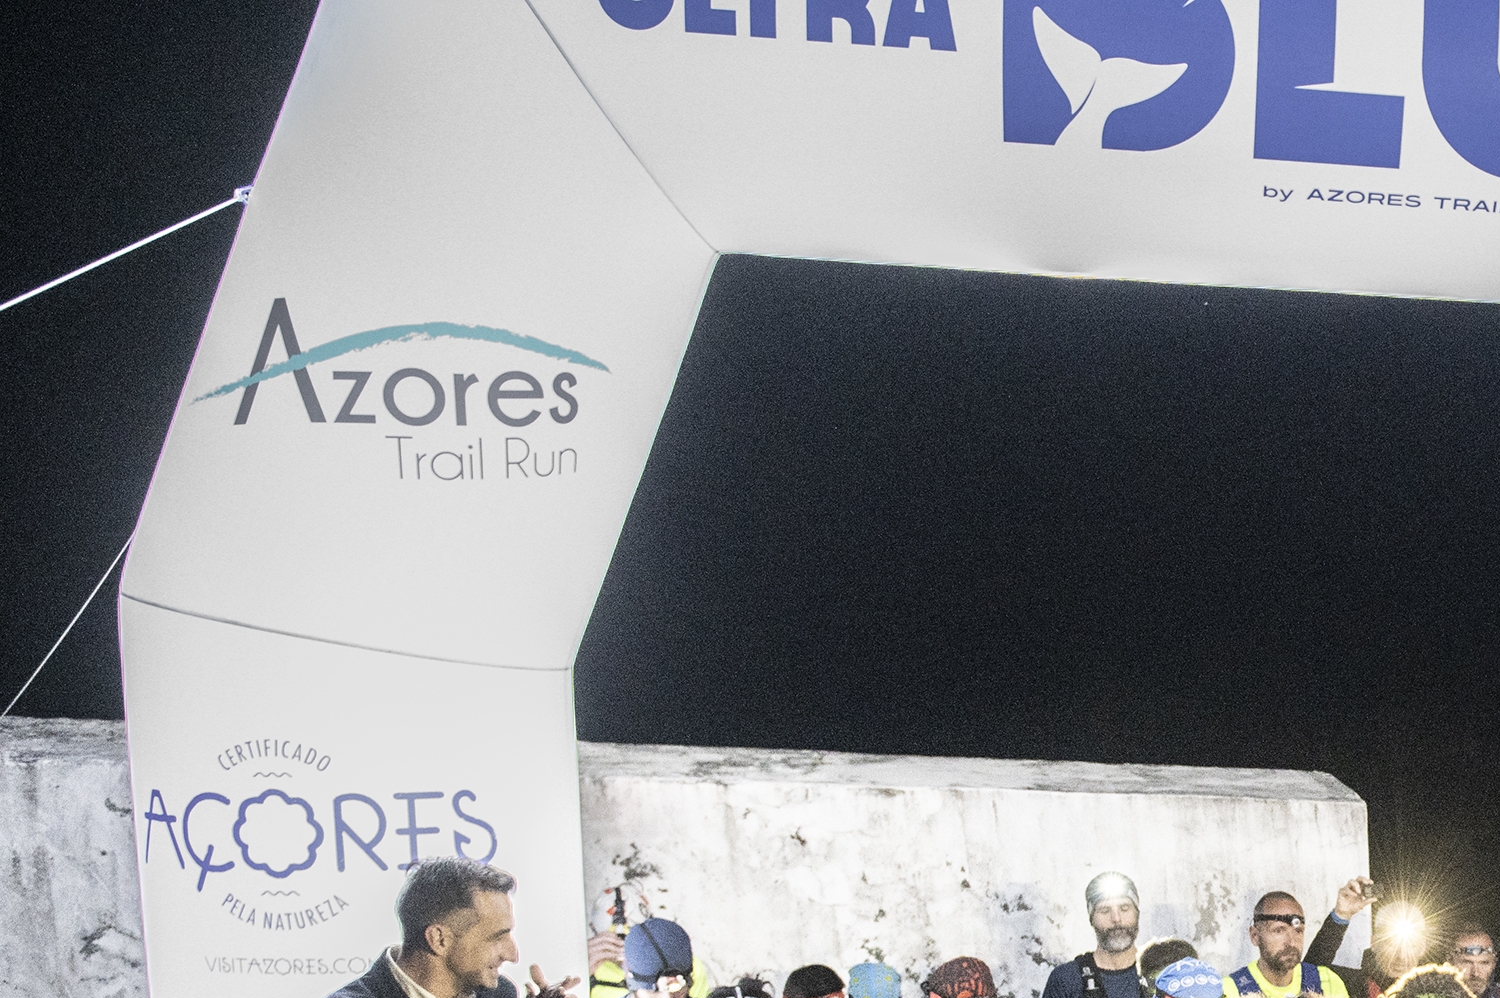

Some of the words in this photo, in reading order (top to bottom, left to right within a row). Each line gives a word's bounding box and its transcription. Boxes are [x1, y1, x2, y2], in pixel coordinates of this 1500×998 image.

[1262, 185, 1294, 202] by
[1306, 187, 1422, 209] AZORES
[233, 297, 580, 427] Azores
[384, 436, 485, 481] Trail
[504, 436, 579, 479] Run
[216, 737, 332, 773] CERTIFICADO
[143, 788, 499, 892] AÇORES
[220, 892, 257, 927] PELA
[262, 893, 350, 931] NATUREZA
[204, 955, 379, 977] VISITAZORES.CO
